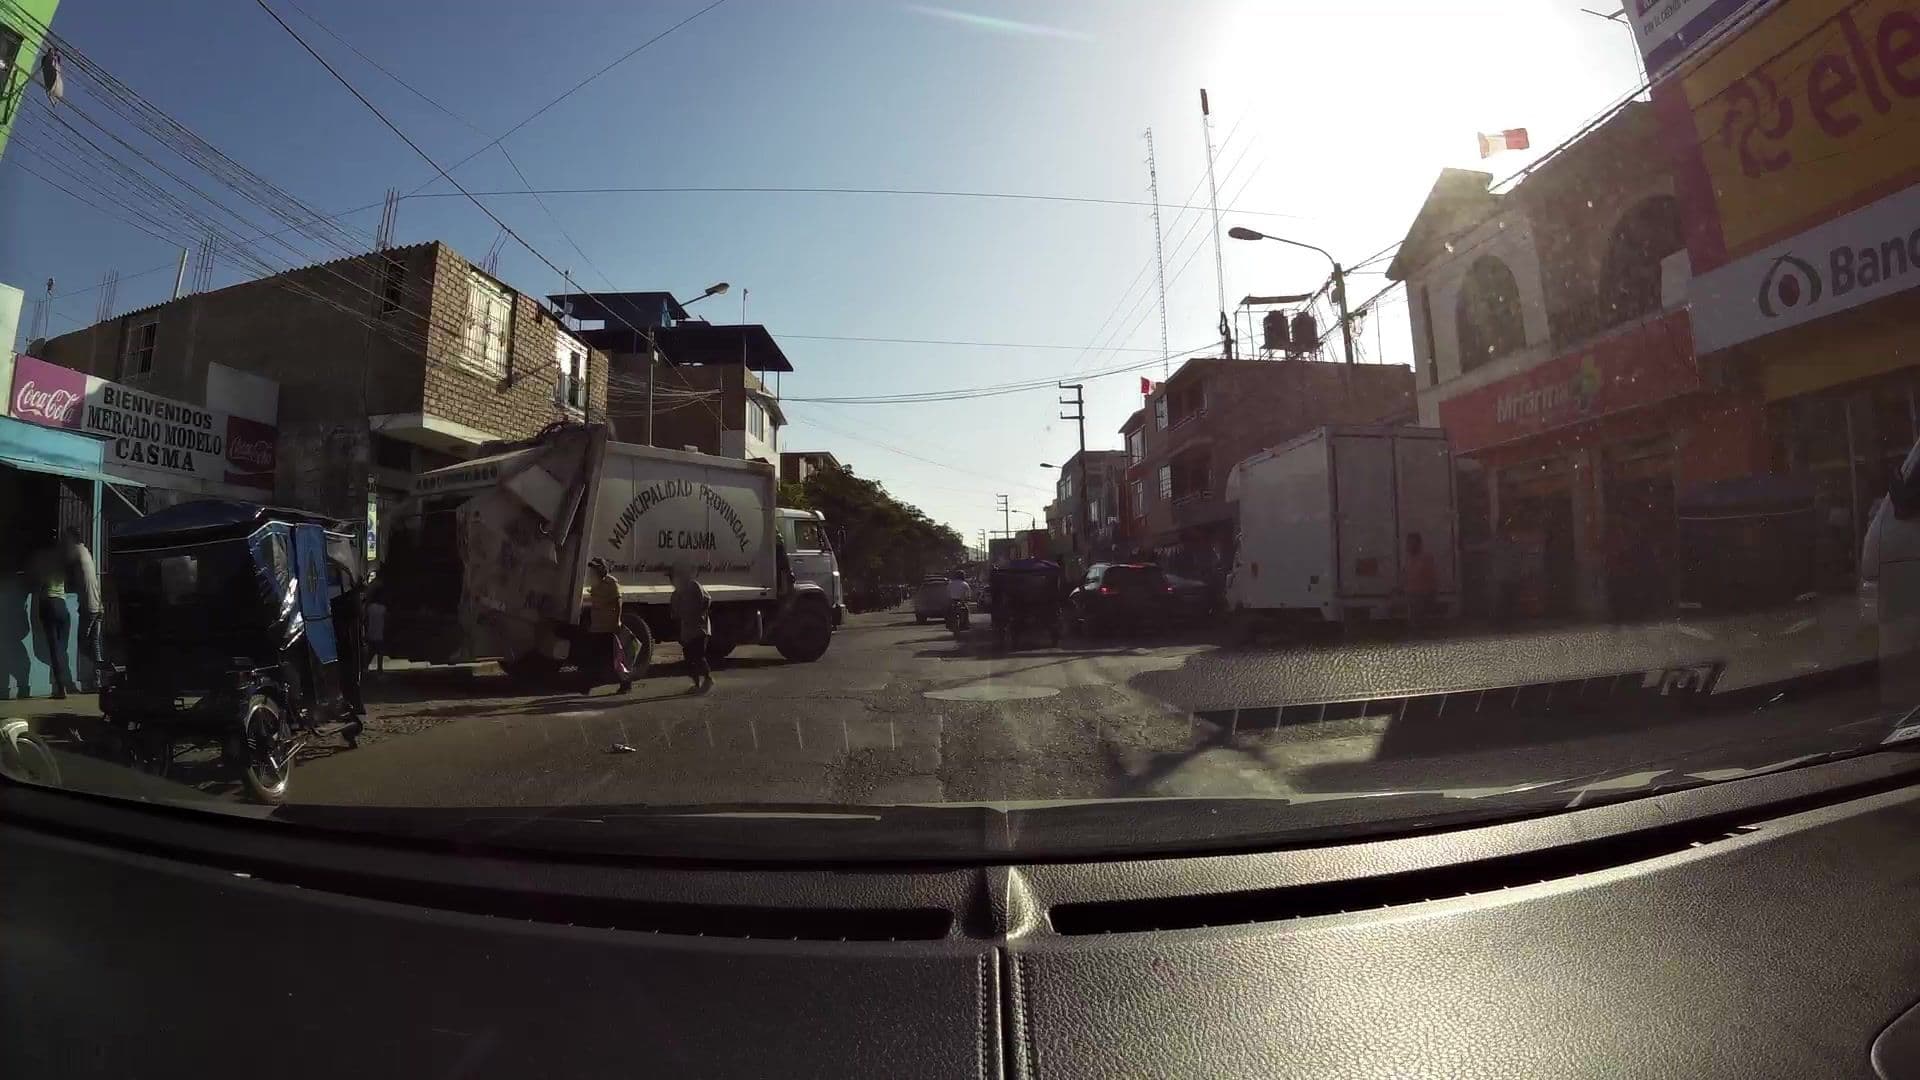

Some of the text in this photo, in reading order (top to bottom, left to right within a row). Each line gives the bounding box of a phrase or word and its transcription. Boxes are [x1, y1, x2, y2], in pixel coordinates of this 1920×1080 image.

[103, 386, 213, 430] BIENVENIDOS
[87, 405, 222, 456] MERCADO MODELO
[115, 438, 195, 472] CASMA
[608, 479, 751, 553] MUNICIPALIDAD PROVINCIAL
[658, 529, 716, 550] DE CASMA
